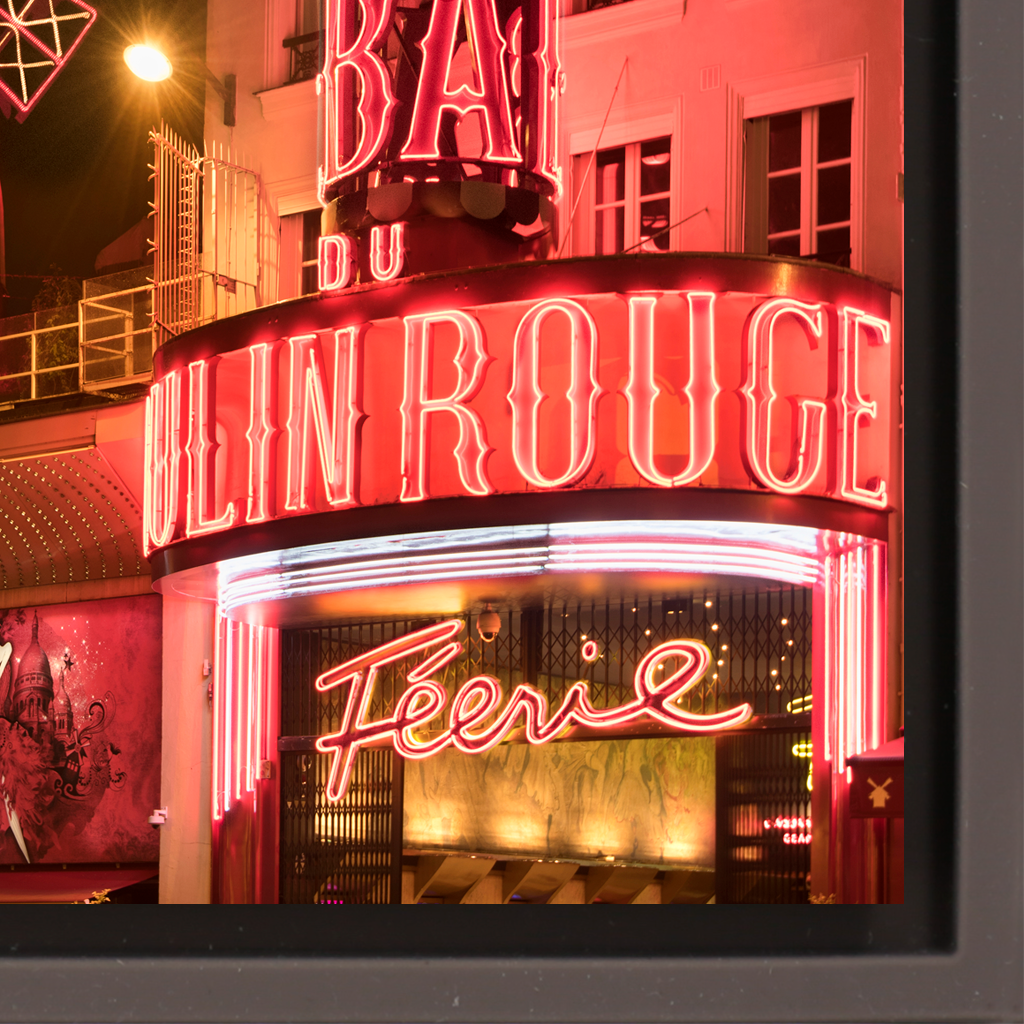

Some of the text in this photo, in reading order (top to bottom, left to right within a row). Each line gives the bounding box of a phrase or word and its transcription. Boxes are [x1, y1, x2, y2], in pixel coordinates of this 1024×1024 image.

[318, 223, 405, 291] DU
[400, 290, 892, 508] ROUGE
[315, 618, 754, 802] Féerie
